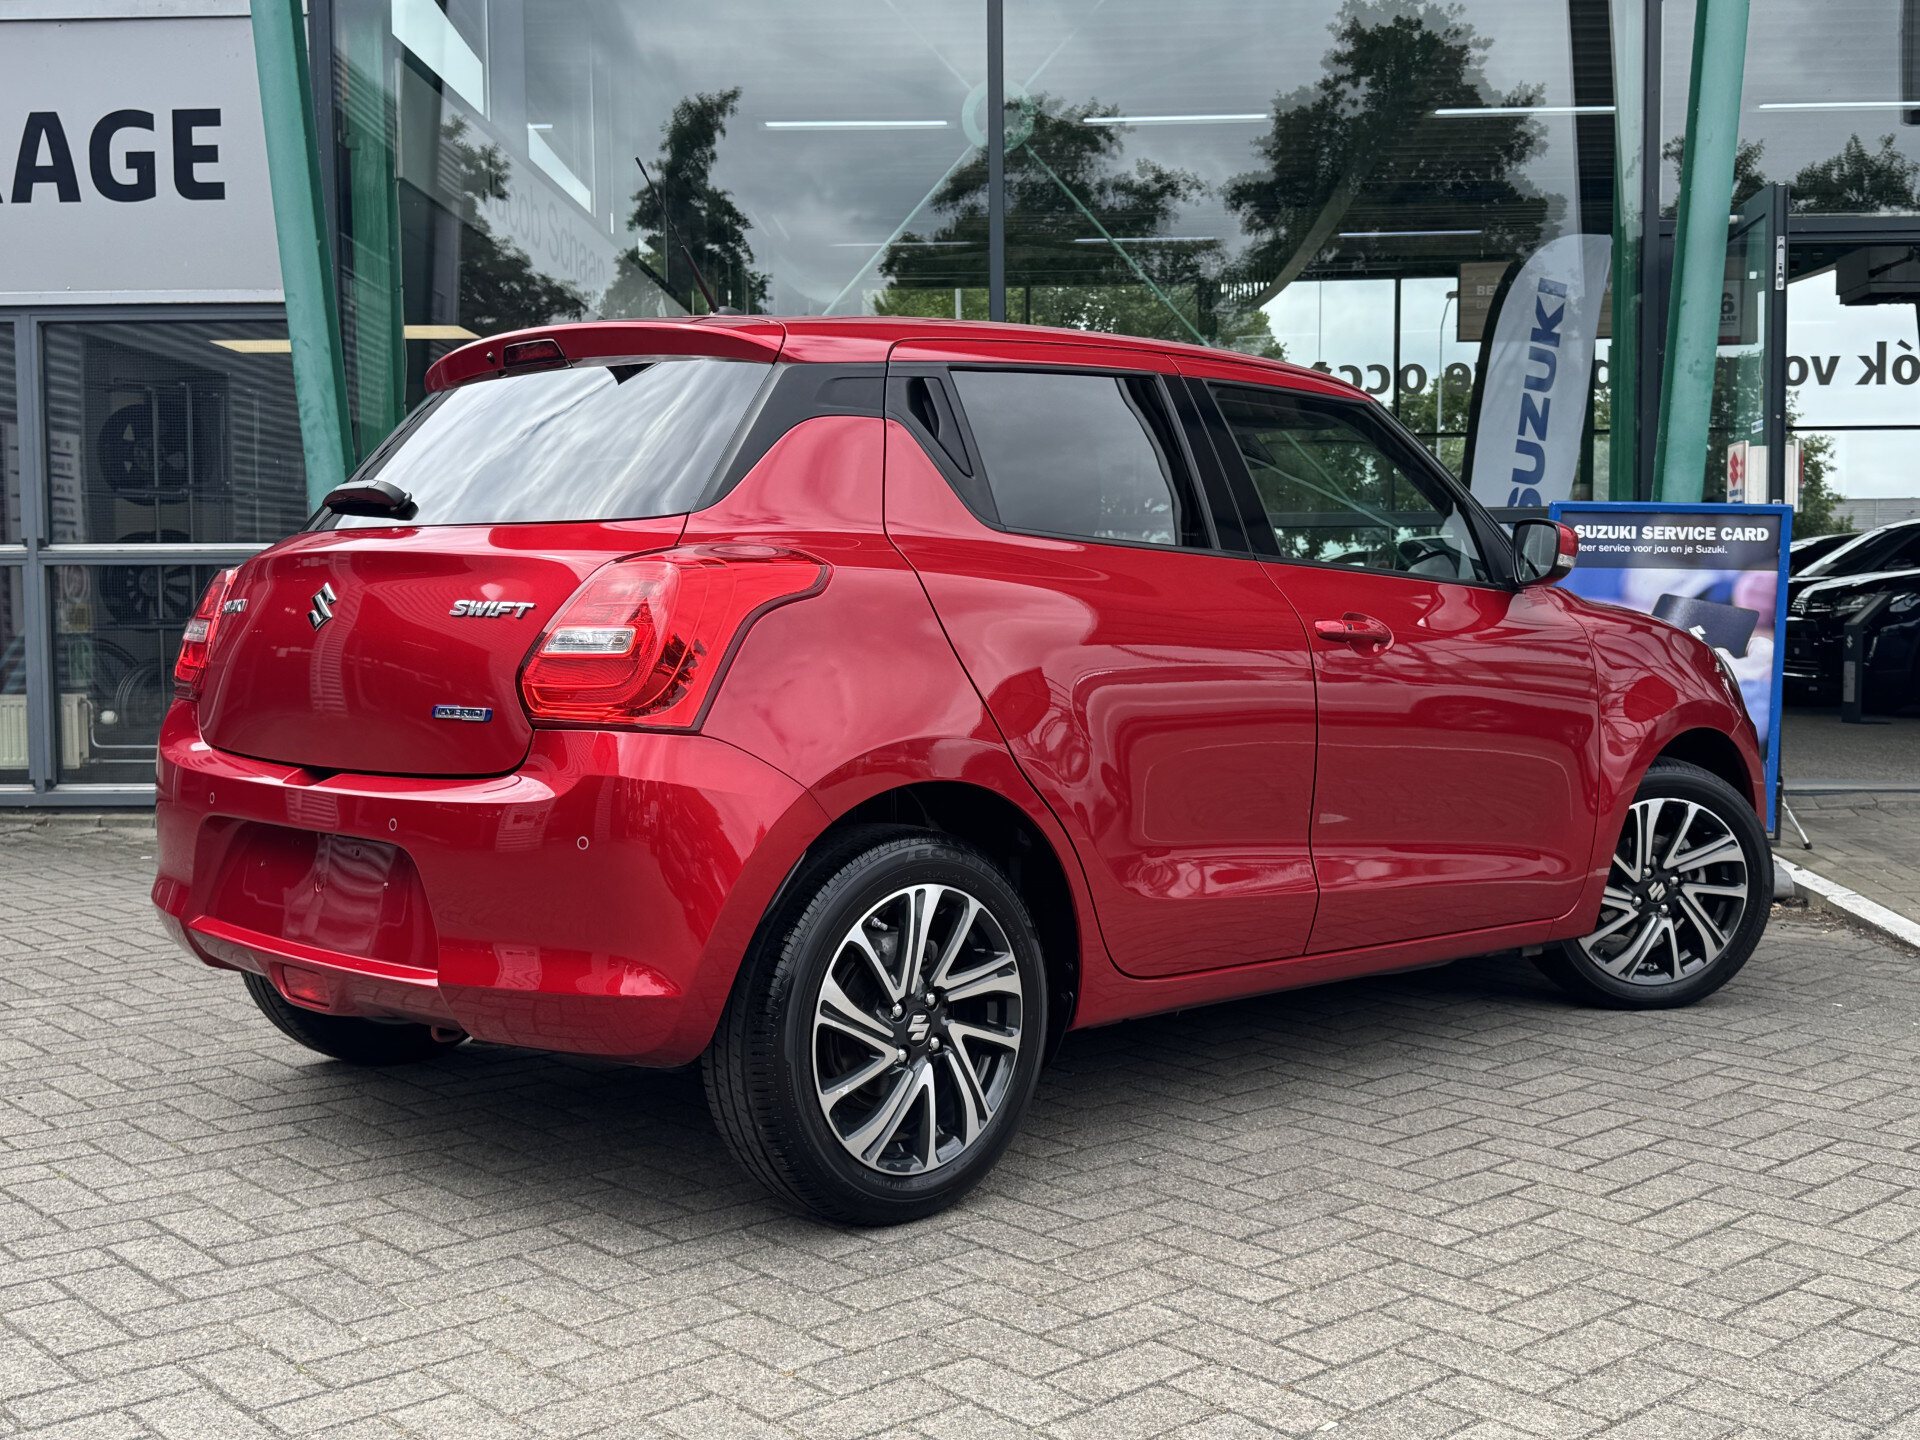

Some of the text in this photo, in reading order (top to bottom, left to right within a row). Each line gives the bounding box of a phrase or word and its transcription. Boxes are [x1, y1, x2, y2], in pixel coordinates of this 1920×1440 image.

[0, 108, 225, 204] AGE
[1573, 524, 1770, 542] SUZUKI SERVICE CARD
[1598, 543, 1631, 553] service
[1632, 545, 1652, 553] voor
[1653, 543, 1669, 555] jou
[1670, 545, 1683, 554] en
[1683, 544, 1693, 555] je
[1695, 544, 1728, 555] Suzuki.
[449, 600, 536, 618] SWIFT
